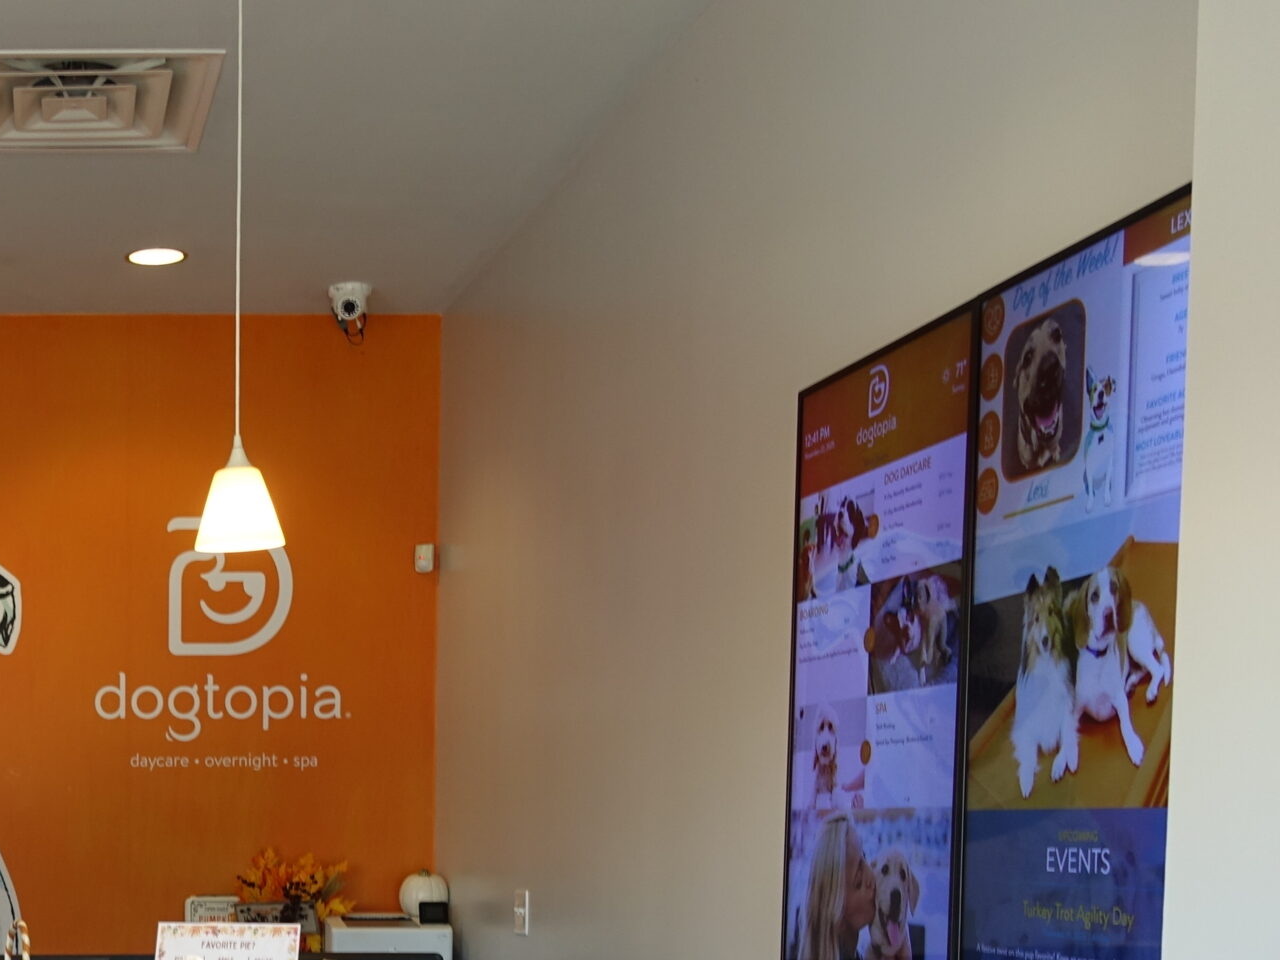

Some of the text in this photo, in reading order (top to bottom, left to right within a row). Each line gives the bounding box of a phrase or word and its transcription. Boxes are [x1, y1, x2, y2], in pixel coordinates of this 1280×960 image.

[1013, 285, 1035, 317] Dog
[1039, 270, 1052, 307] of
[1054, 260, 1073, 291] the
[856, 415, 897, 447] dogtopia
[884, 469, 900, 486] DOG
[900, 456, 932, 481] DAYCARE
[130, 753, 318, 771] daycare overnight spa
[1046, 847, 1111, 875] EVENTS
[1023, 900, 1135, 933] Turkey Trot Agility Day
[201, 941, 256, 950] FAVORITE PIE?
